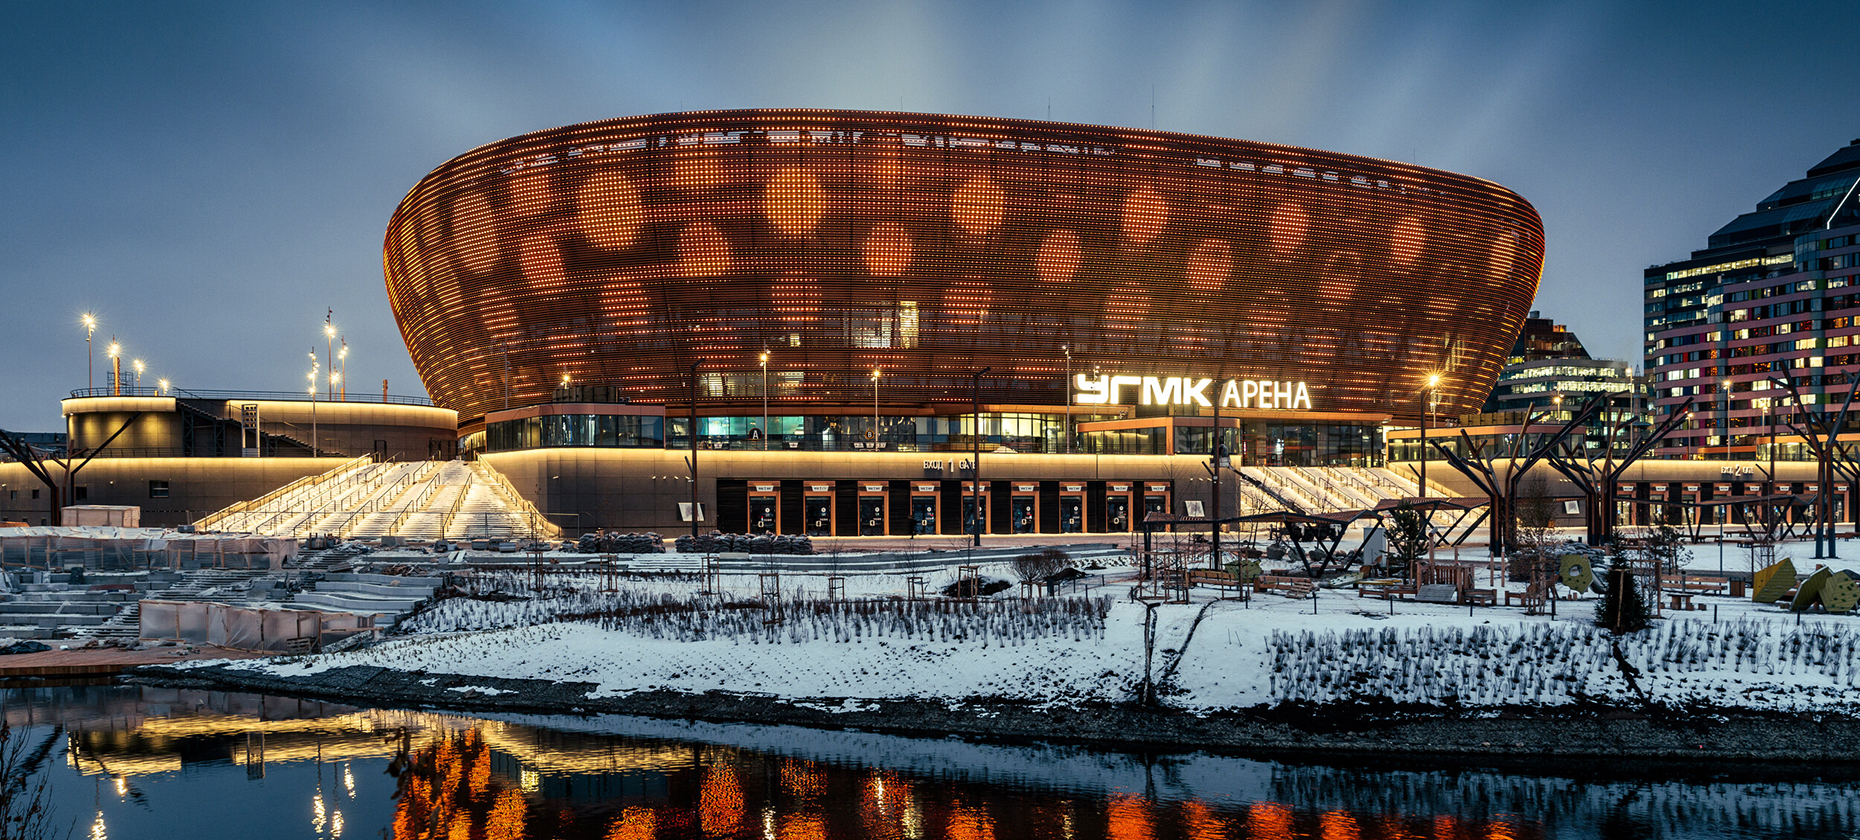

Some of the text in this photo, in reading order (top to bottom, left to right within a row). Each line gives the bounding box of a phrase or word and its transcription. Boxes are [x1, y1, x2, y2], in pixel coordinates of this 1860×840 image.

[1073, 373, 1312, 409] УГМК АРЕНА
[923, 460, 944, 470] ВХОД
[948, 457, 954, 473] 1
[1735, 464, 1741, 477] 2
